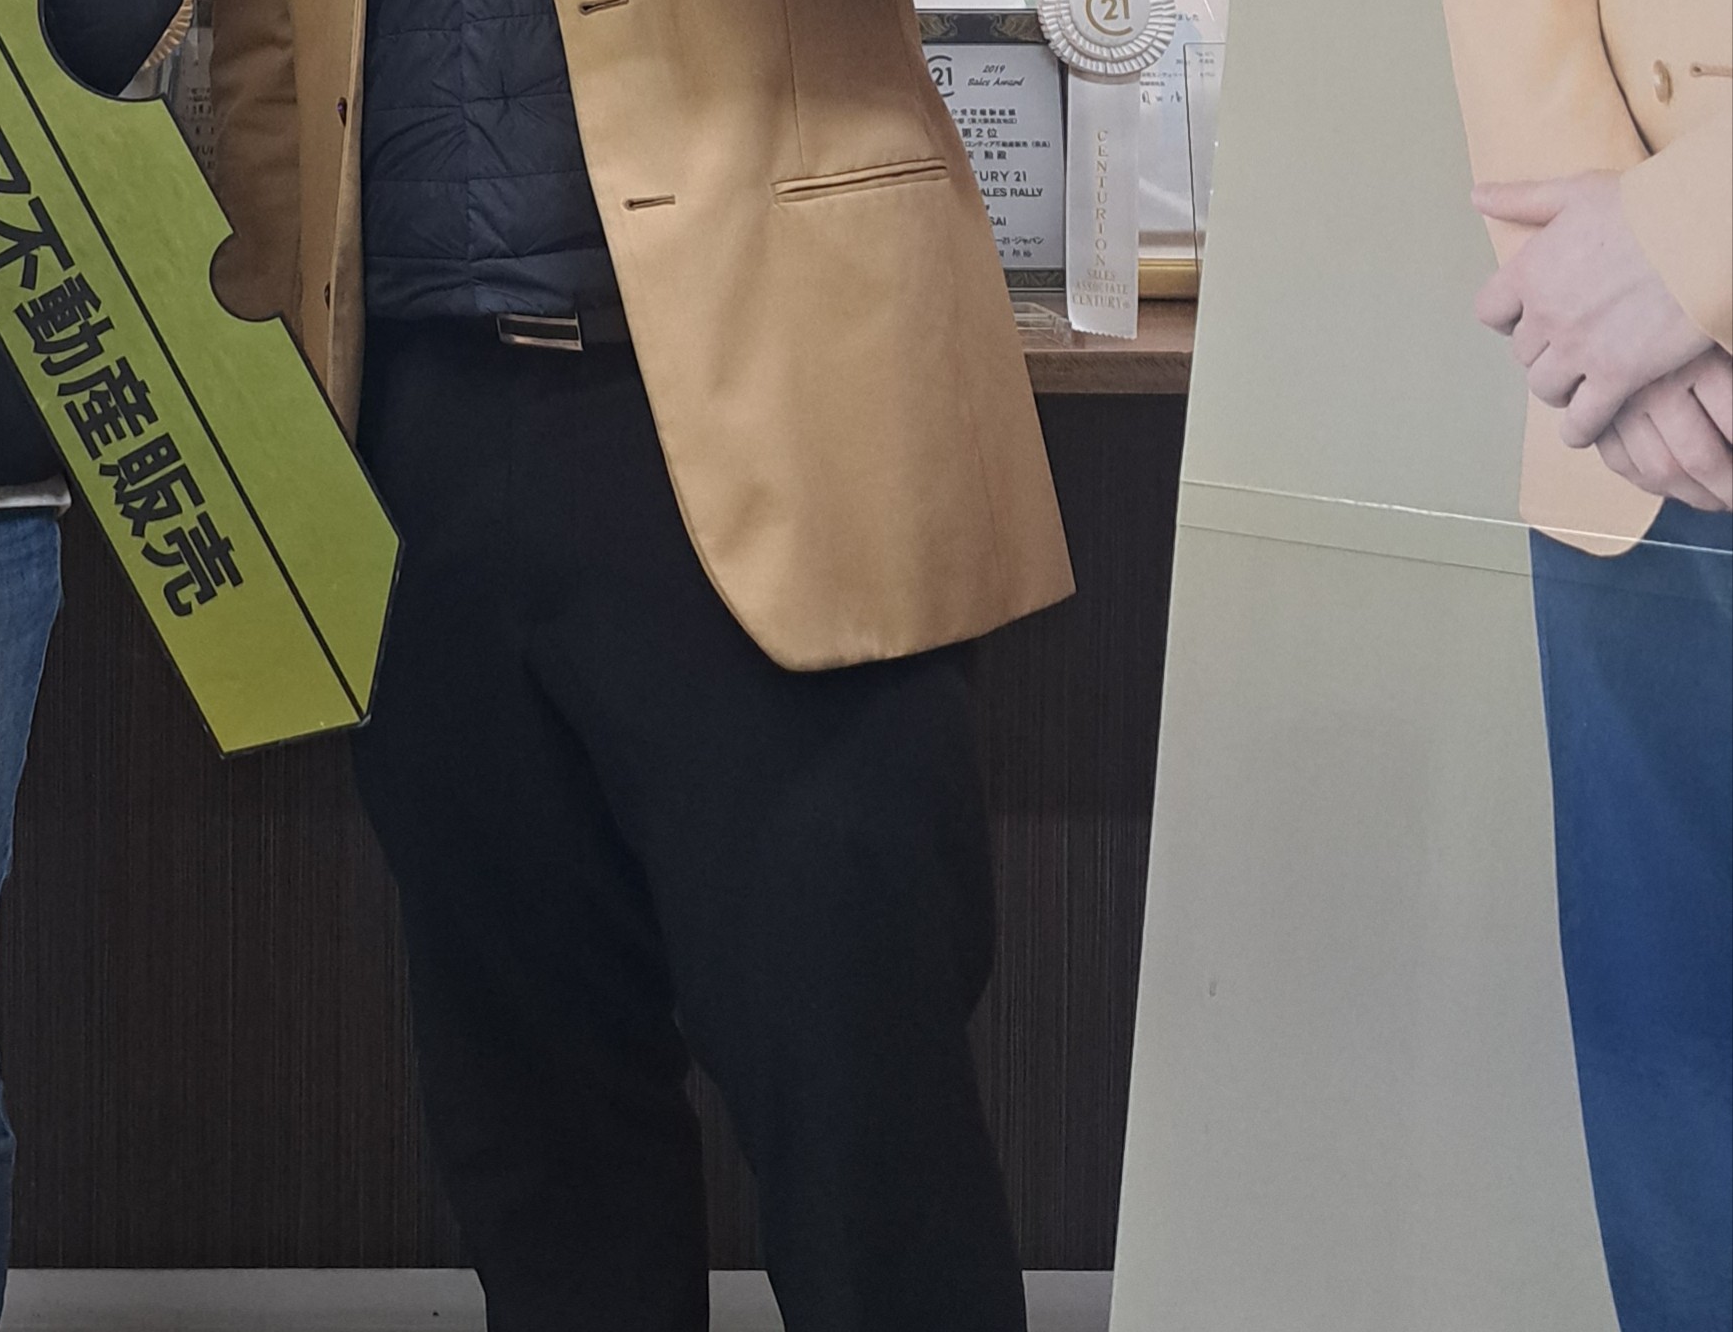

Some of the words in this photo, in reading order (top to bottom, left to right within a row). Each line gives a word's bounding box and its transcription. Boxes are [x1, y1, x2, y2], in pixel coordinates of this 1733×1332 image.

[982, 64, 1006, 73] 2019
[1014, 170, 1027, 182] 21
[1010, 188, 1043, 197] RALLY
[1095, 130, 1109, 267] CENTURION
